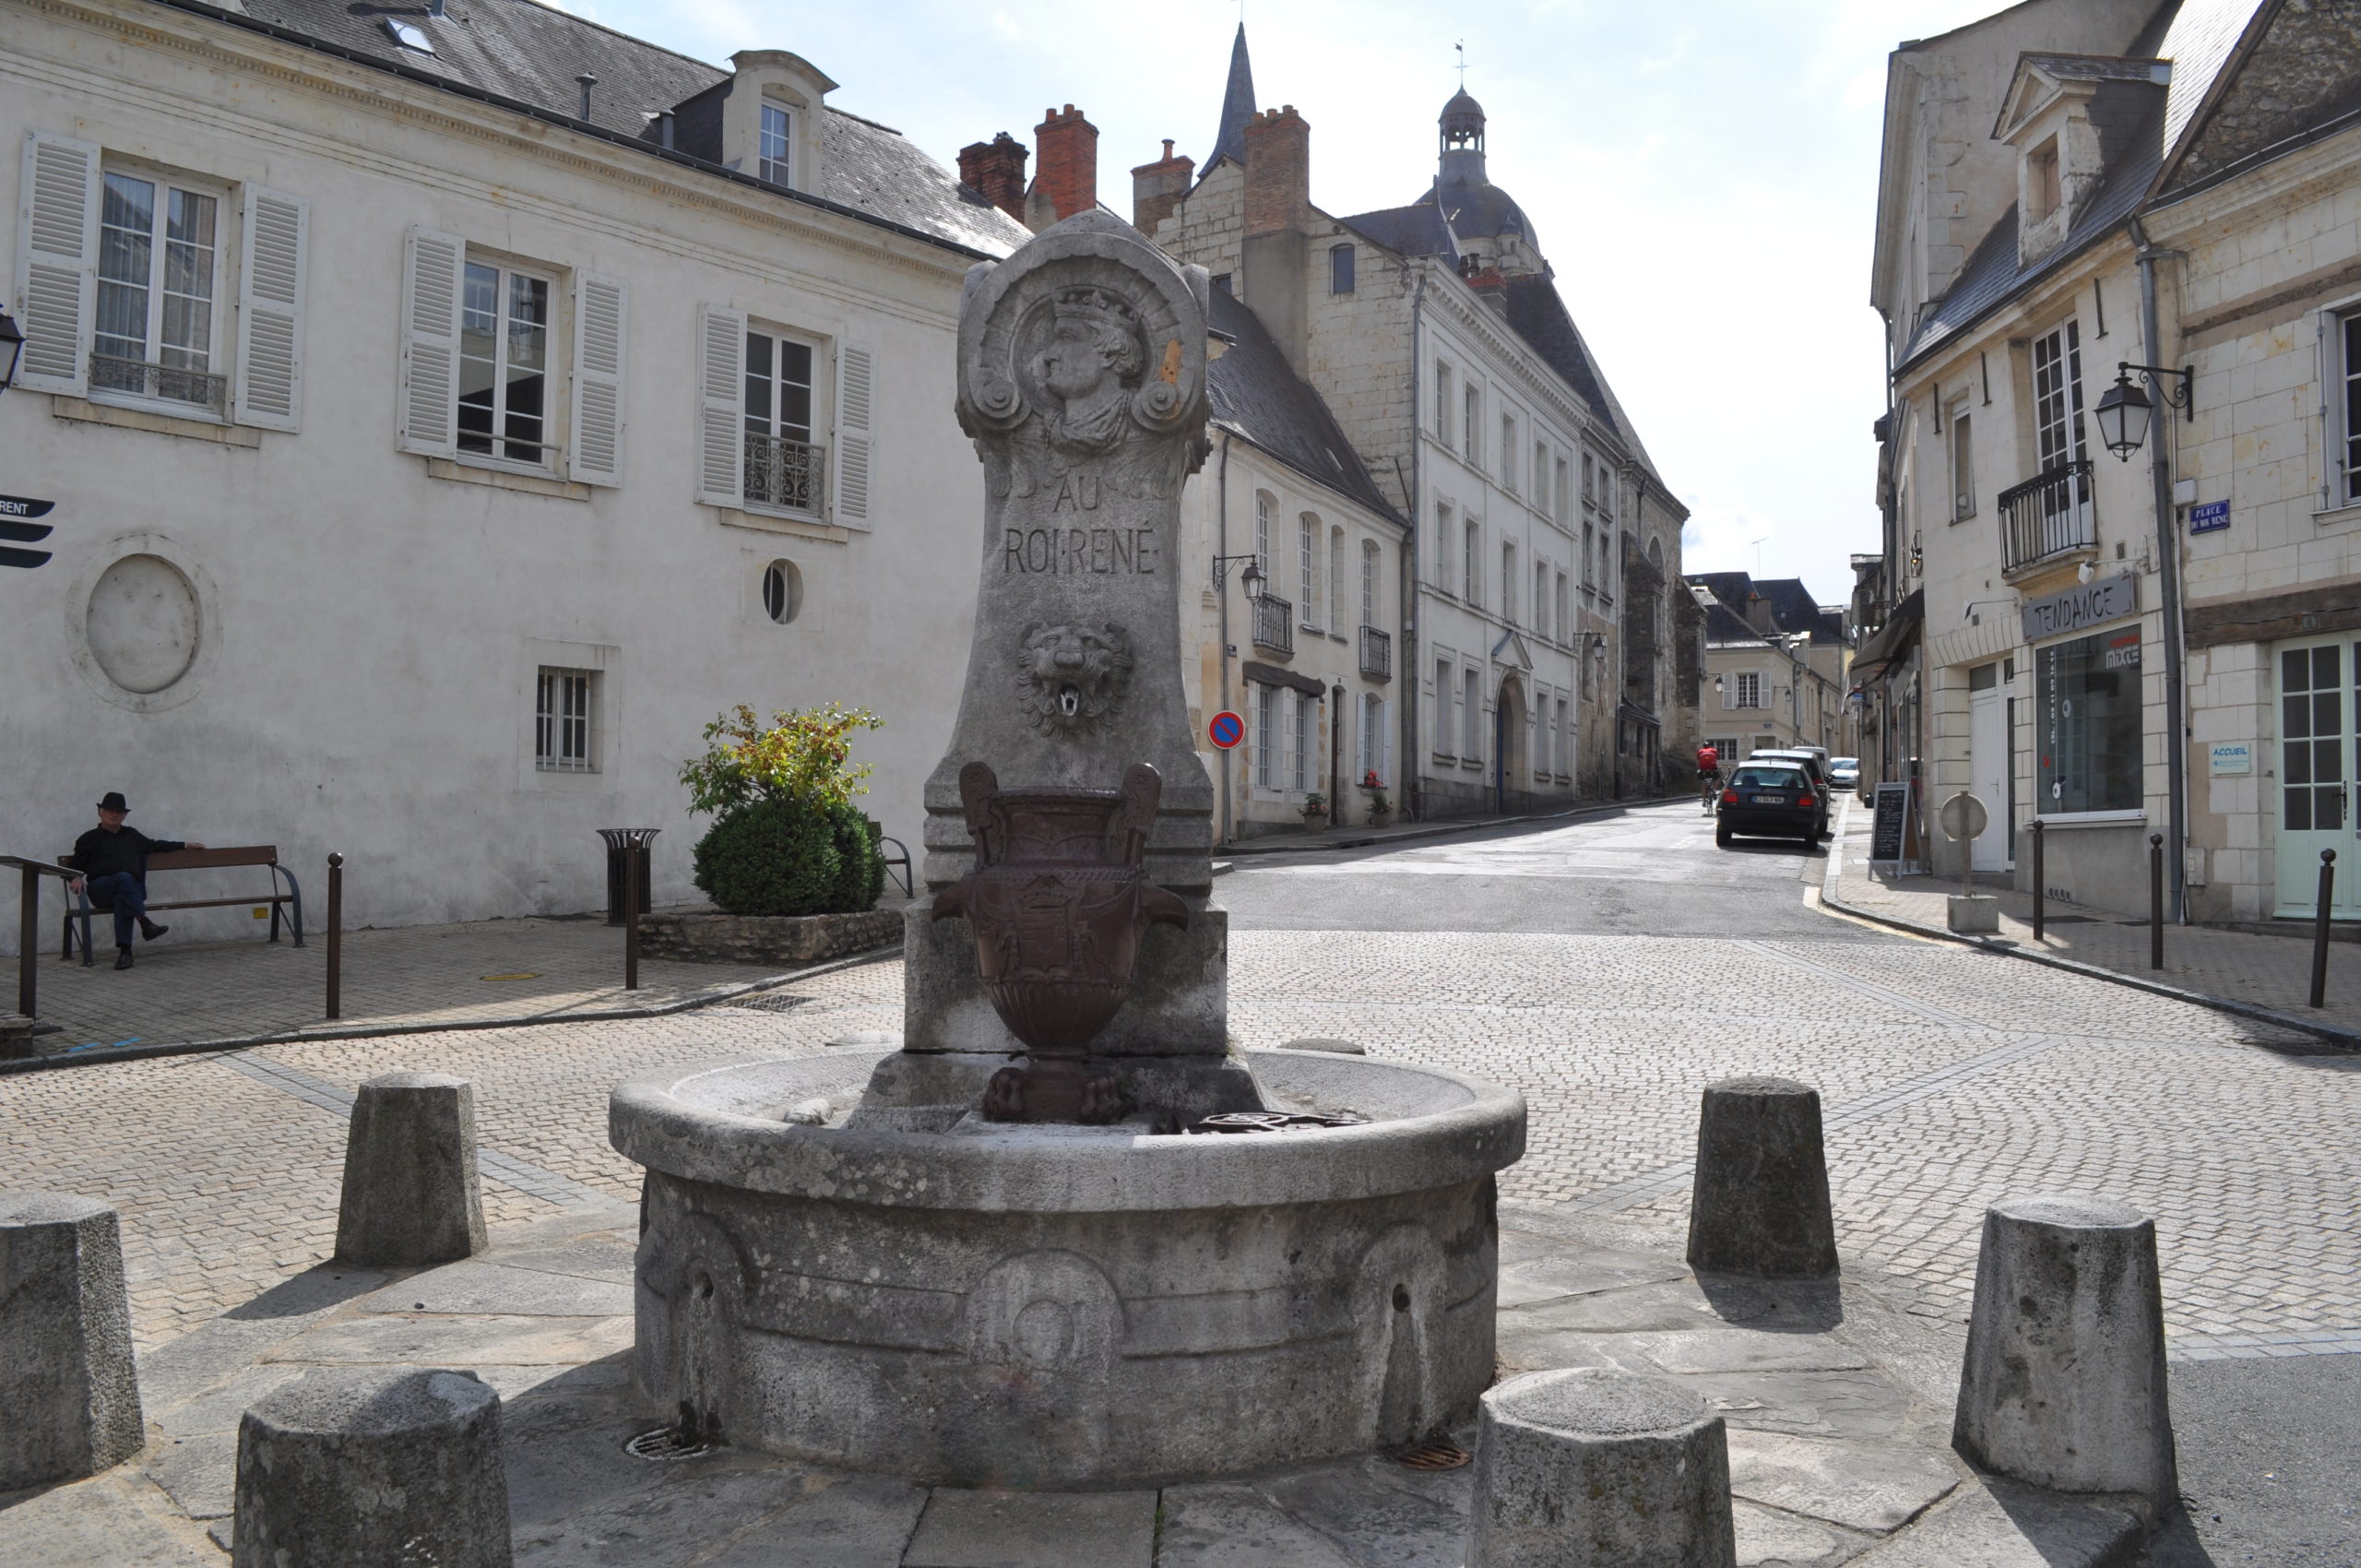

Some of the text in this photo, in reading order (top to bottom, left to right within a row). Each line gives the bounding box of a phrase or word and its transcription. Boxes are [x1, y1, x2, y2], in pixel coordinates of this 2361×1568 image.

[1052, 475, 1100, 513] AU
[2195, 505, 2221, 518] PLACE
[1004, 528, 1060, 574] ROI
[2035, 586, 2114, 634] TENDANCE
[2213, 747, 2248, 756] ACCUEIL
